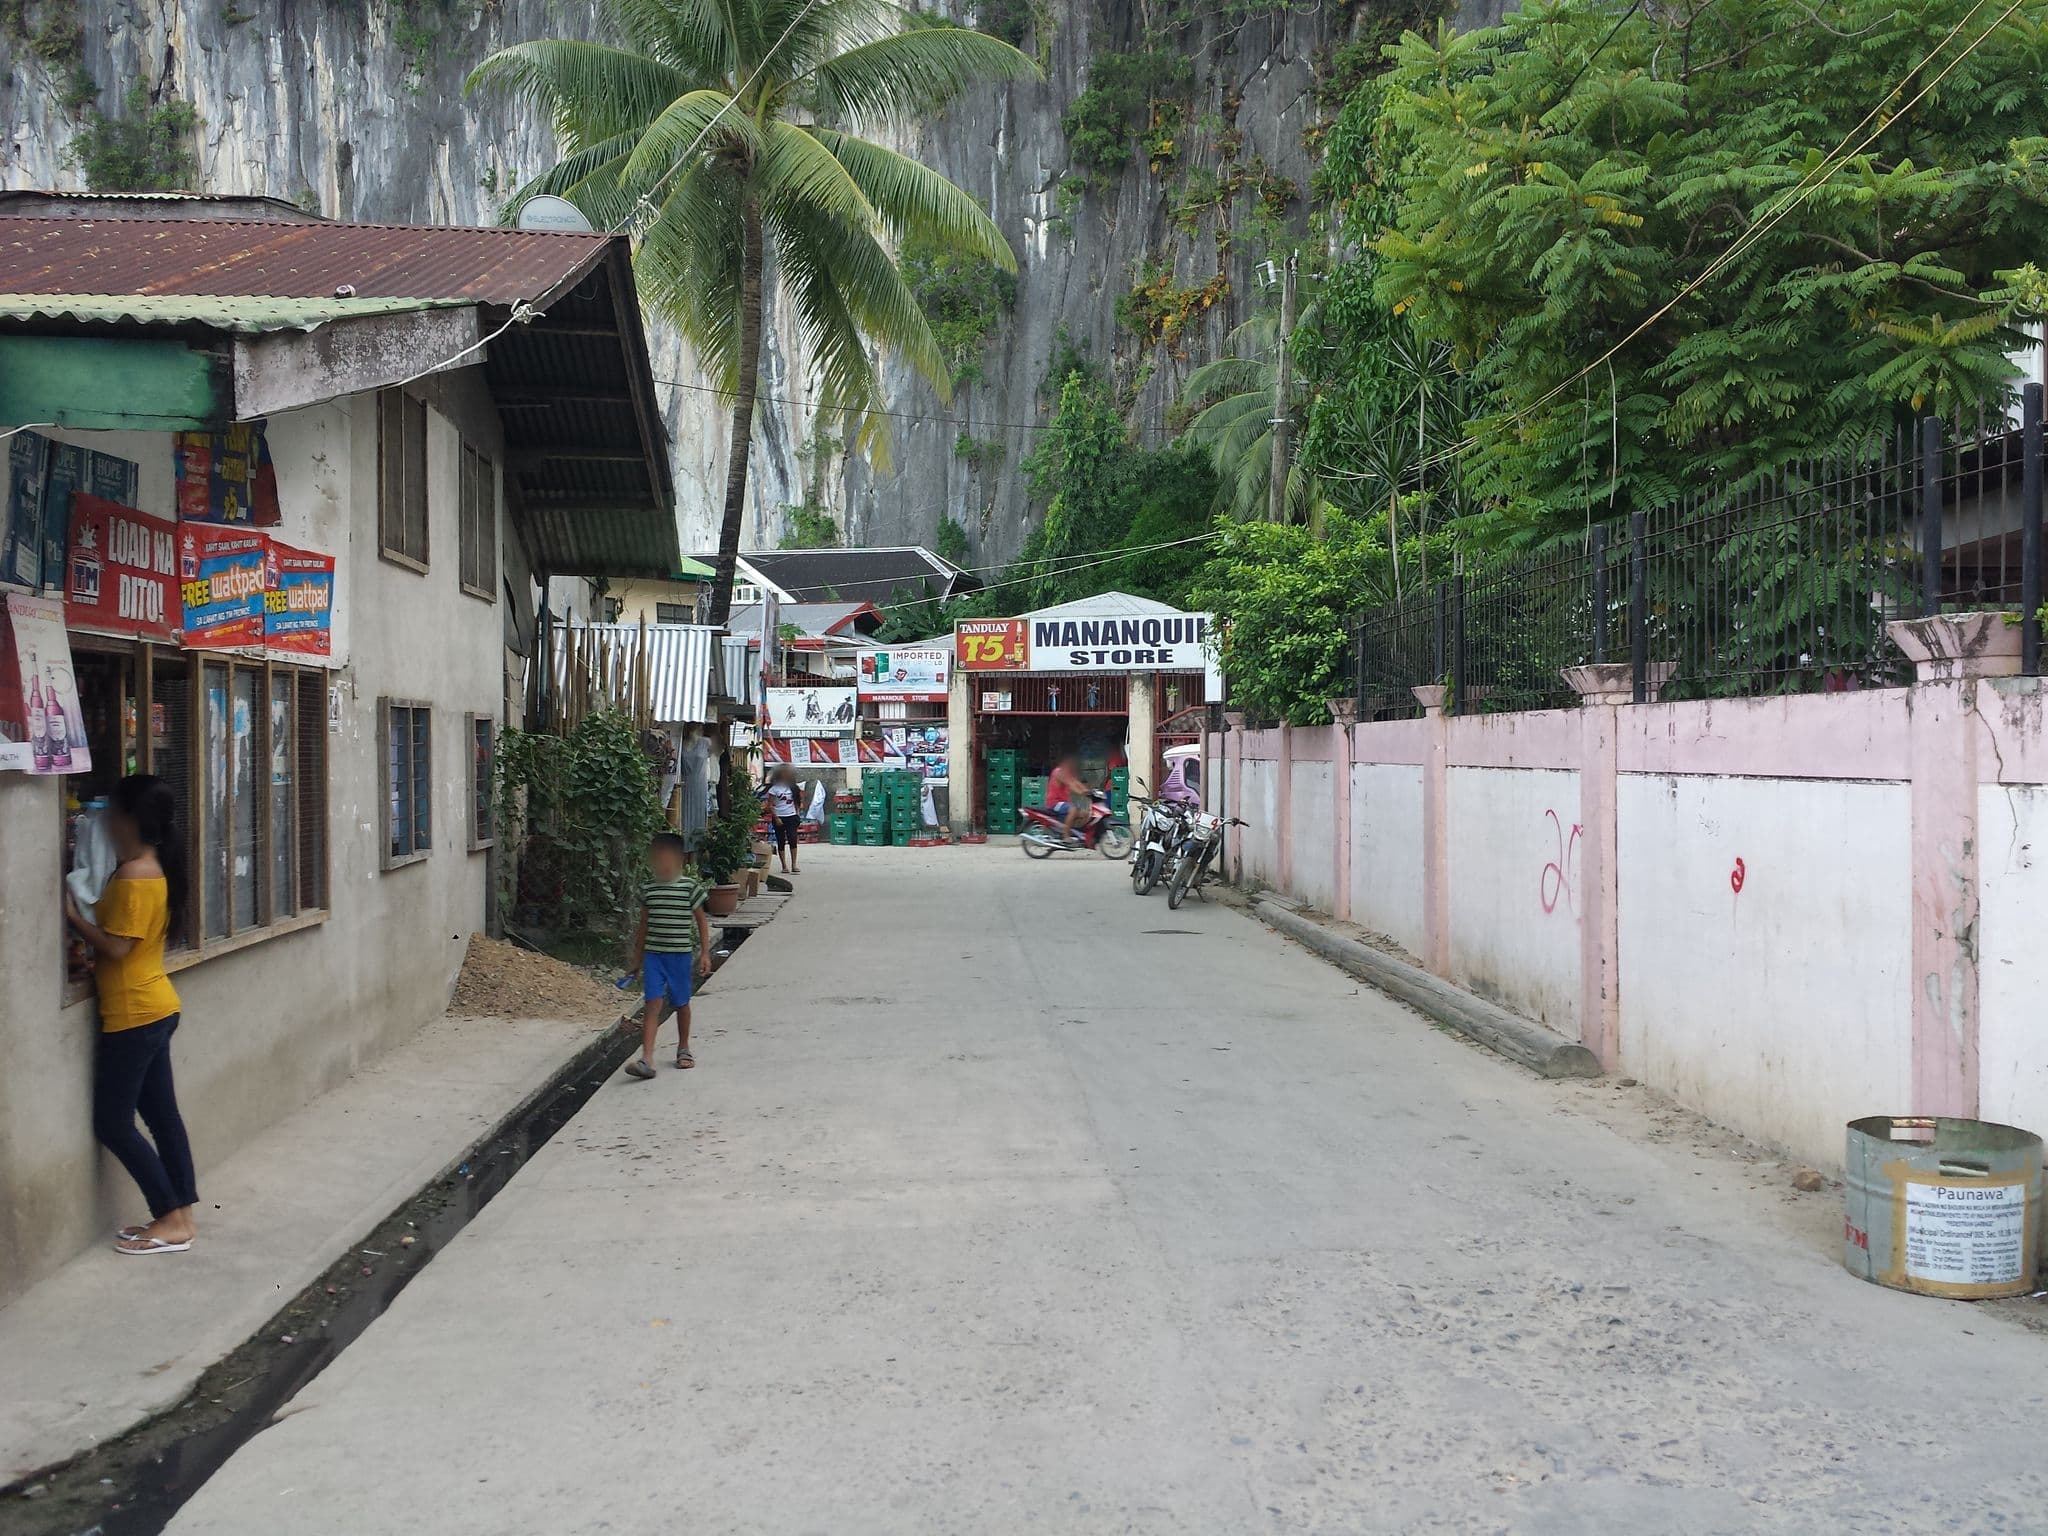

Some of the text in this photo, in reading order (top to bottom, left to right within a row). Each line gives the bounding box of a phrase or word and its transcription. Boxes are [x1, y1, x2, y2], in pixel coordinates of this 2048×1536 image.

[108, 516, 175, 576] LOAD NA
[73, 560, 99, 595] TM
[181, 561, 264, 608] FREE wattpad
[119, 573, 164, 623] DITO!
[265, 583, 328, 614] FREE wattpad
[960, 623, 1010, 634] TANDUAY
[893, 652, 945, 660] IMPORTED.
[963, 635, 1006, 662] T5
[1070, 649, 1174, 666] STORE
[822, 730, 840, 738] Store
[0, 752, 21, 762] ALTH
